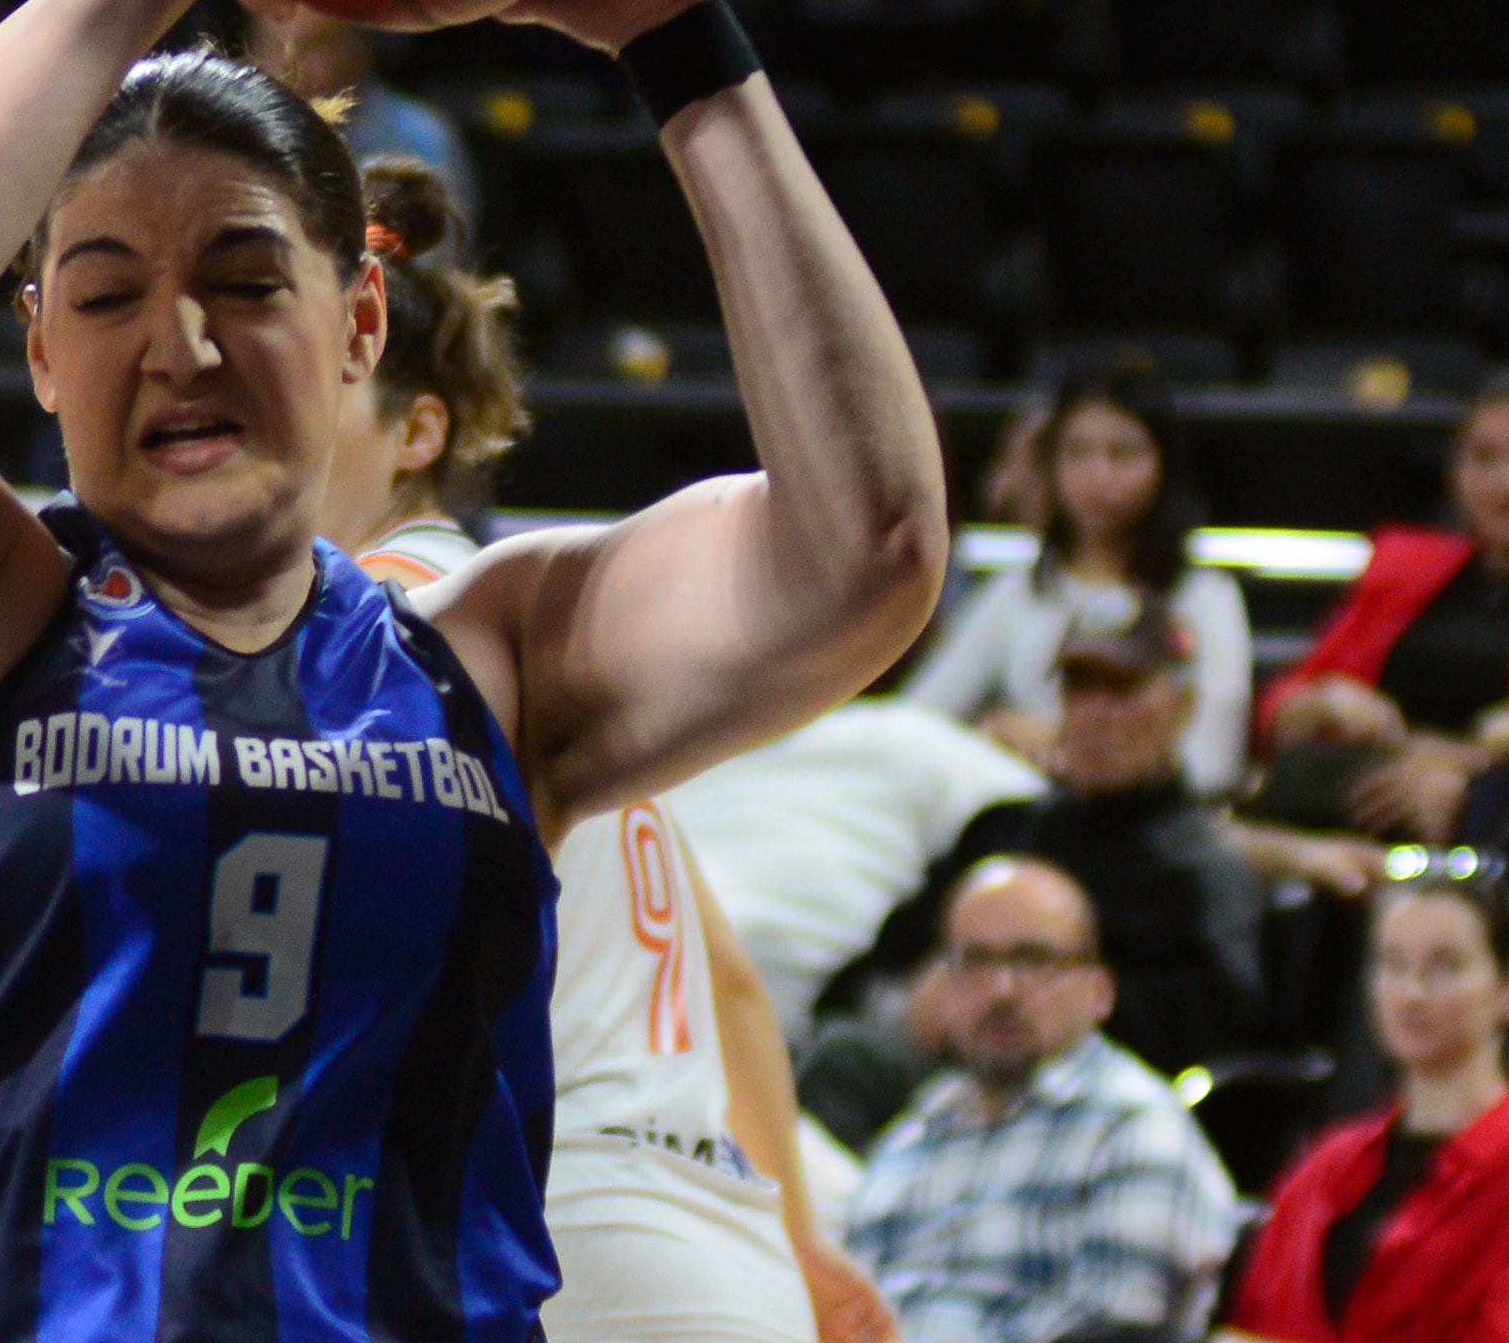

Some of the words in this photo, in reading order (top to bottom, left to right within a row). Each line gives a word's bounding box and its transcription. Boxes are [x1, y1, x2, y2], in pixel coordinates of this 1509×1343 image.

[14, 711, 221, 796] BODRUM
[233, 737, 510, 825] BASKETBOL
[195, 831, 330, 1041] 9
[620, 799, 692, 1055] 9
